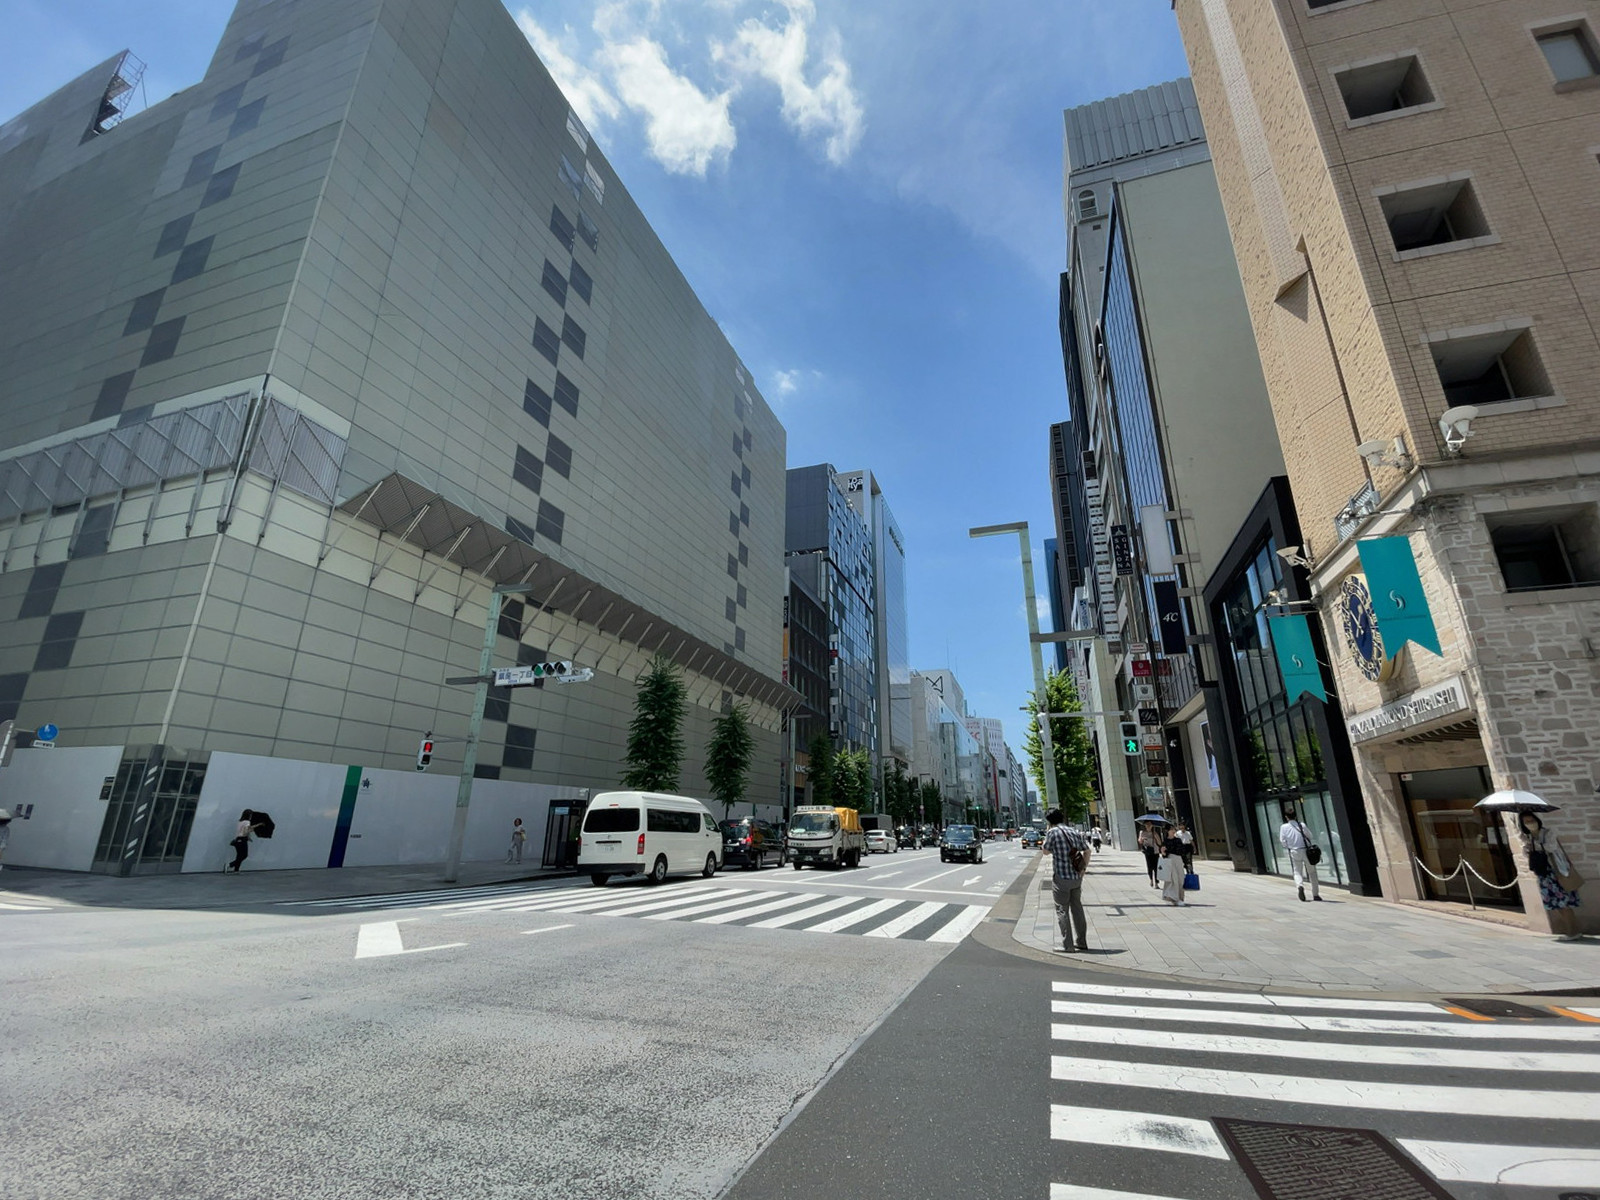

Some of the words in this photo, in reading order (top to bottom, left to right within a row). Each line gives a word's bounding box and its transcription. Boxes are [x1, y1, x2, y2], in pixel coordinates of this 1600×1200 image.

[1114, 538, 1124, 568] SALON
[1121, 537, 1131, 568] GINZA
[1408, 686, 1456, 718] SHIRAISHI
